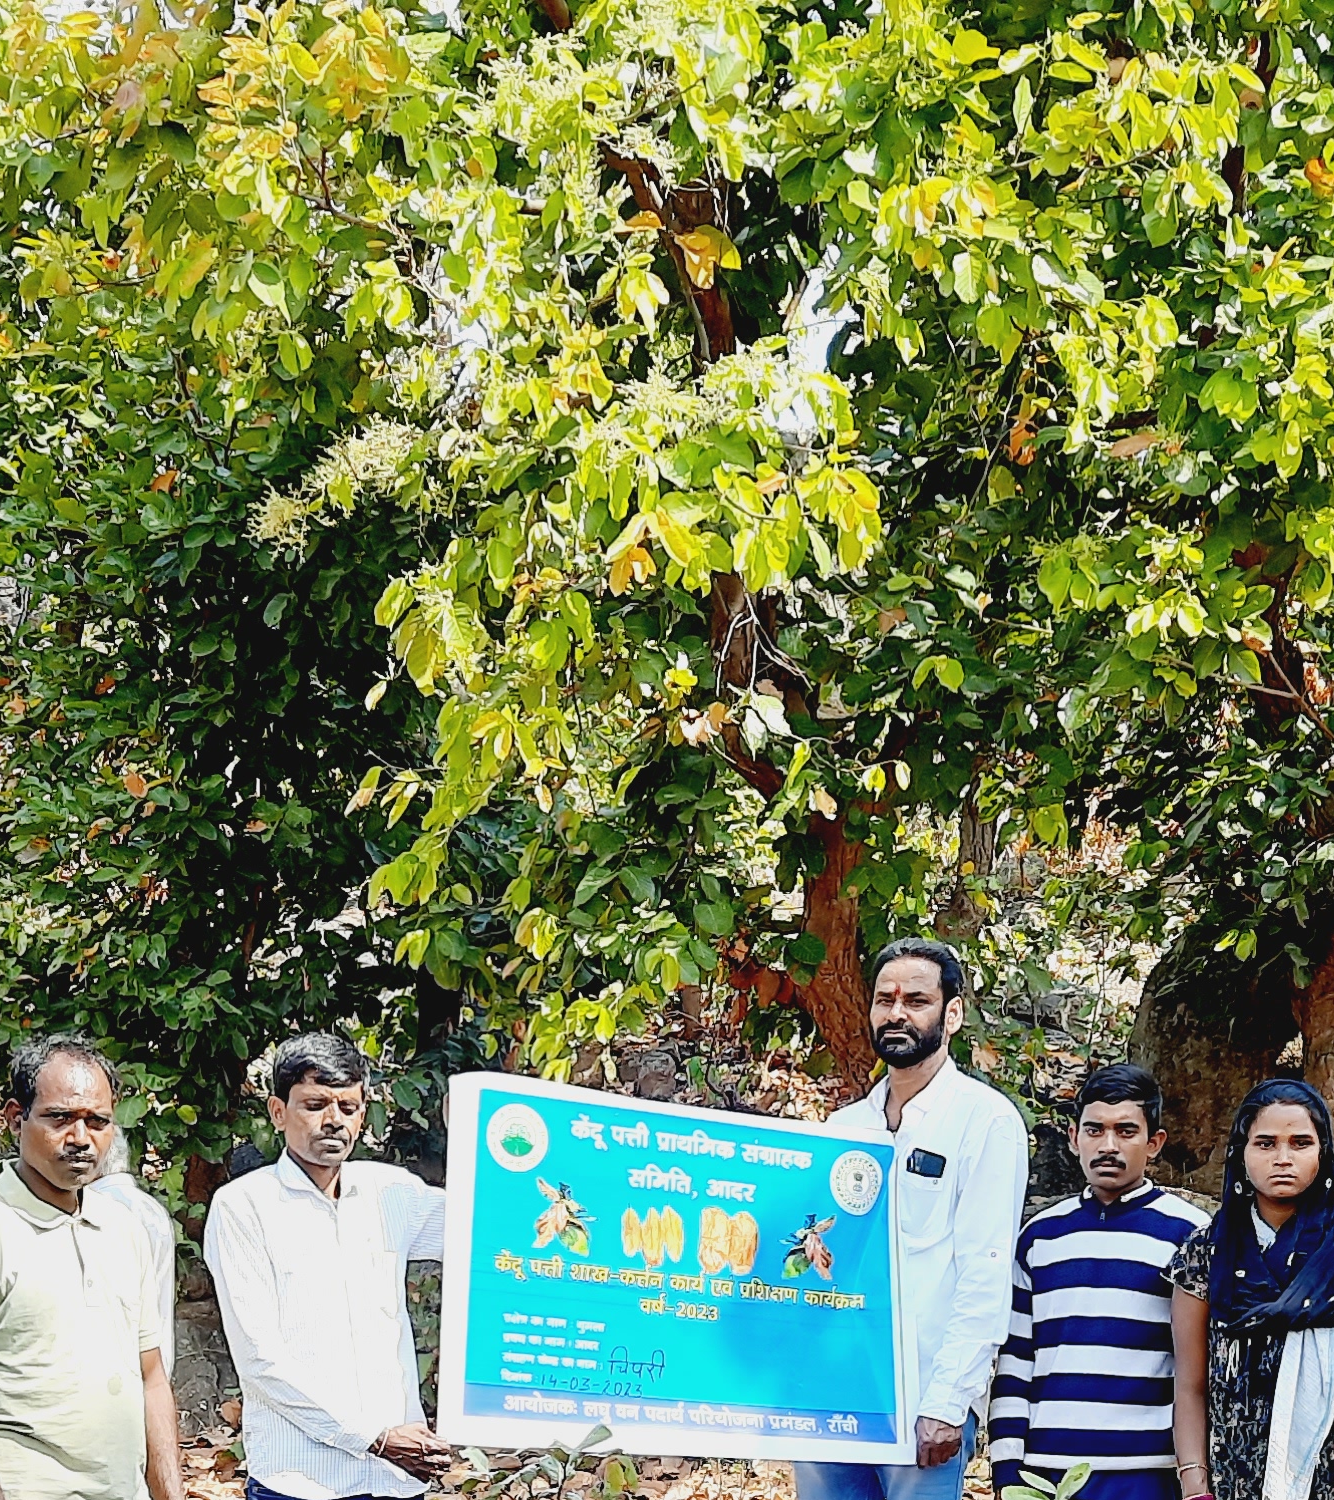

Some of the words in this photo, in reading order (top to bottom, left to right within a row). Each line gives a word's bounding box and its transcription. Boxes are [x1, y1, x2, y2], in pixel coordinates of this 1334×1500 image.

[611, 1121, 650, 1149] पत्ती
[656, 1129, 736, 1160] प्राथमिक
[740, 1139, 814, 1170] संग्राहक
[627, 1163, 698, 1199] समिति,
[706, 1178, 757, 1203] आदर
[529, 1254, 565, 1279] पत्ती
[669, 1270, 706, 1294] कार्य
[710, 1275, 734, 1297] एवं
[739, 1277, 799, 1304] प्रशिक्षण
[803, 1284, 866, 1311] कार्यक्रम
[582, 1400, 612, 1425] लघु
[643, 1401, 685, 1424] पदार्थ
[688, 1404, 764, 1429] परियोजना
